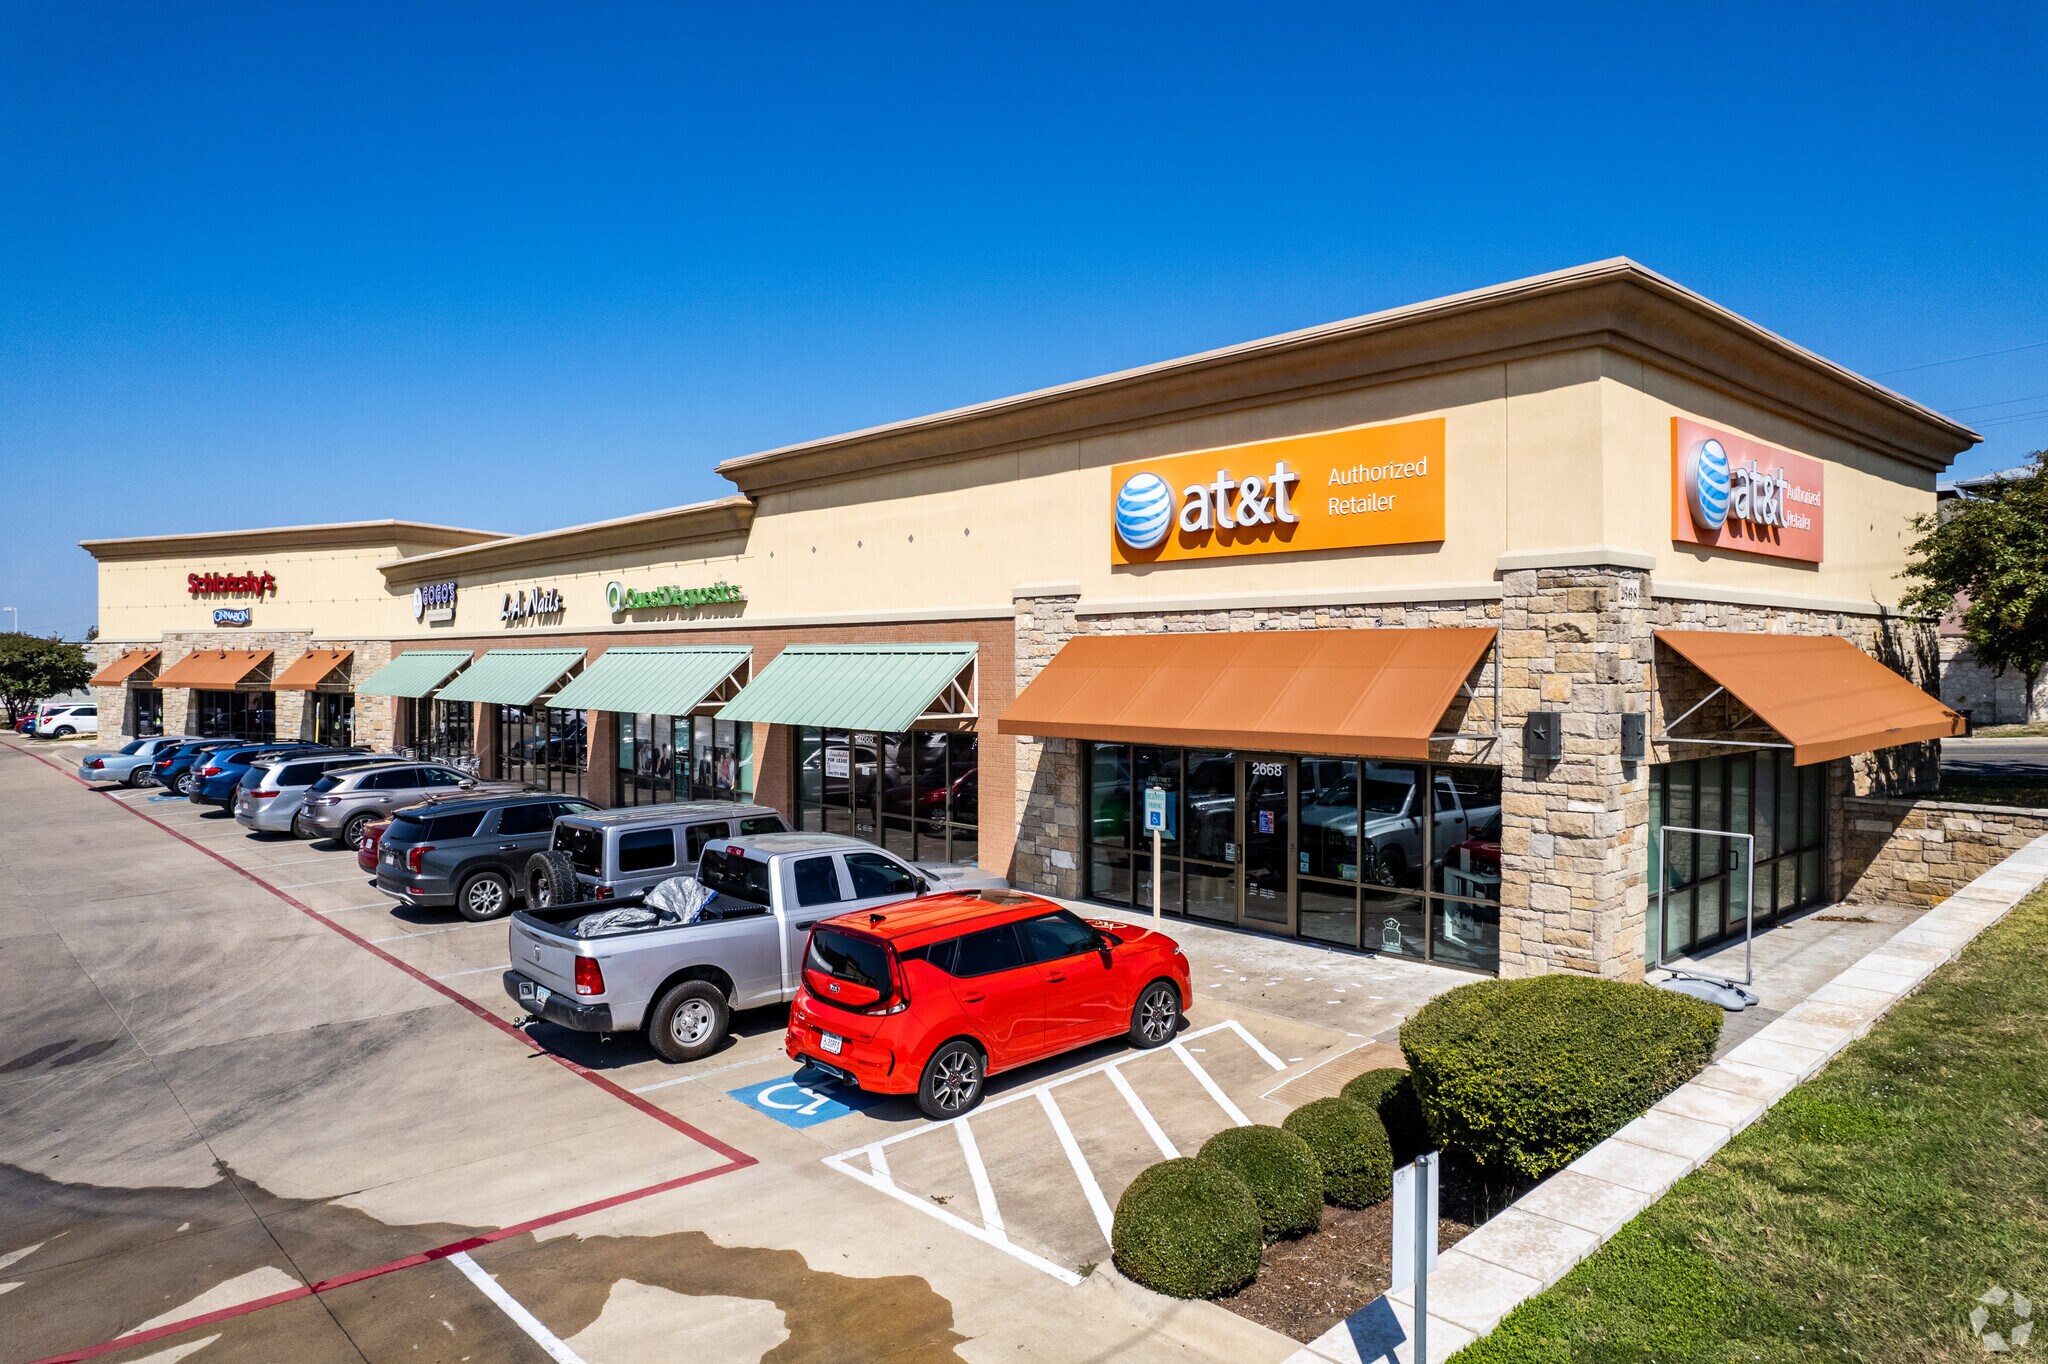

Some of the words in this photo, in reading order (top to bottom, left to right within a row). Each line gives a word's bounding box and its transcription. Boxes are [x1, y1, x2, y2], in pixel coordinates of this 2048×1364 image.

[1328, 456, 1428, 487] Authorized
[1179, 461, 1300, 532] at&t
[1328, 492, 1396, 516] Retailer
[1735, 459, 1788, 529] at&t
[1786, 484, 1821, 507] Authorized
[1786, 510, 1812, 530] Retailer
[187, 570, 274, 597] Schlotzsky's
[213, 609, 249, 622] CINNABON
[500, 591, 524, 621] L.A.
[526, 586, 561, 617] Nails
[1252, 762, 1282, 776] 2668
